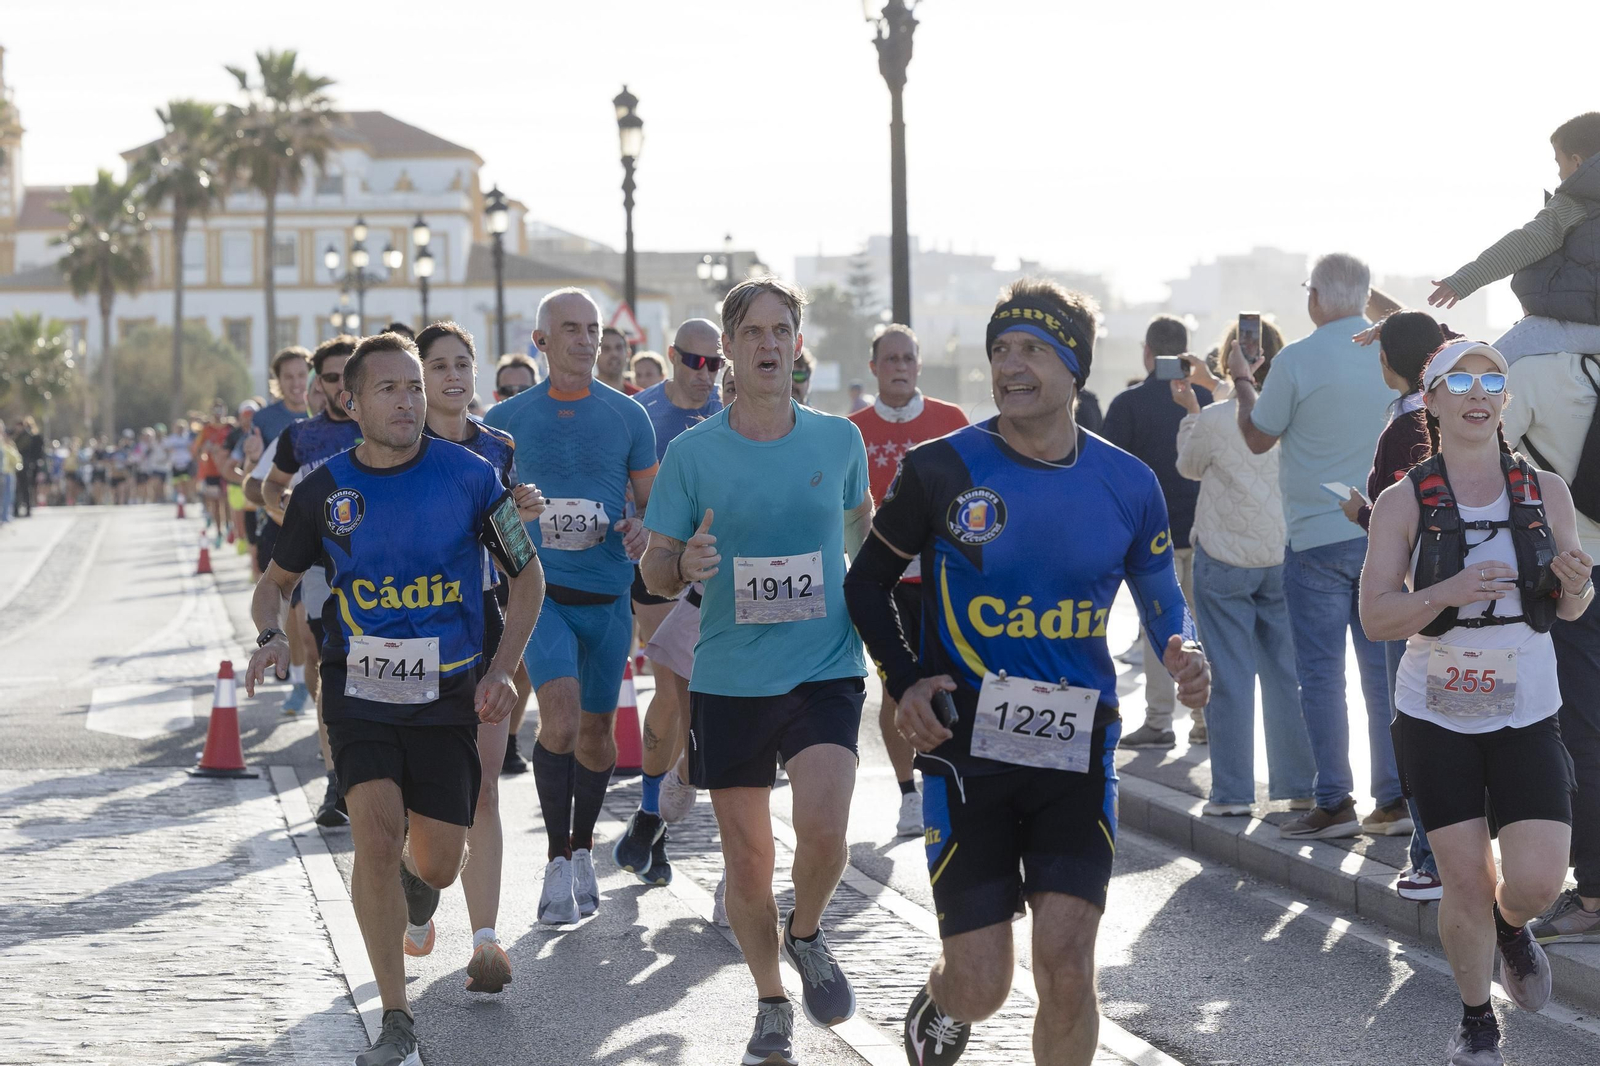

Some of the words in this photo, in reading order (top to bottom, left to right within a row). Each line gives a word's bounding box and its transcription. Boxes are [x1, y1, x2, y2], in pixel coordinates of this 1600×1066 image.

[326, 490, 359, 505] Runners
[956, 490, 1000, 505] Runners
[550, 514, 599, 533] 1231
[352, 574, 463, 610] Cádiz
[747, 573, 812, 601] 1912
[967, 595, 1108, 640] Cádiz
[359, 655, 426, 682] 1744
[1443, 666, 1496, 693] 255
[994, 701, 1078, 741] 1225
